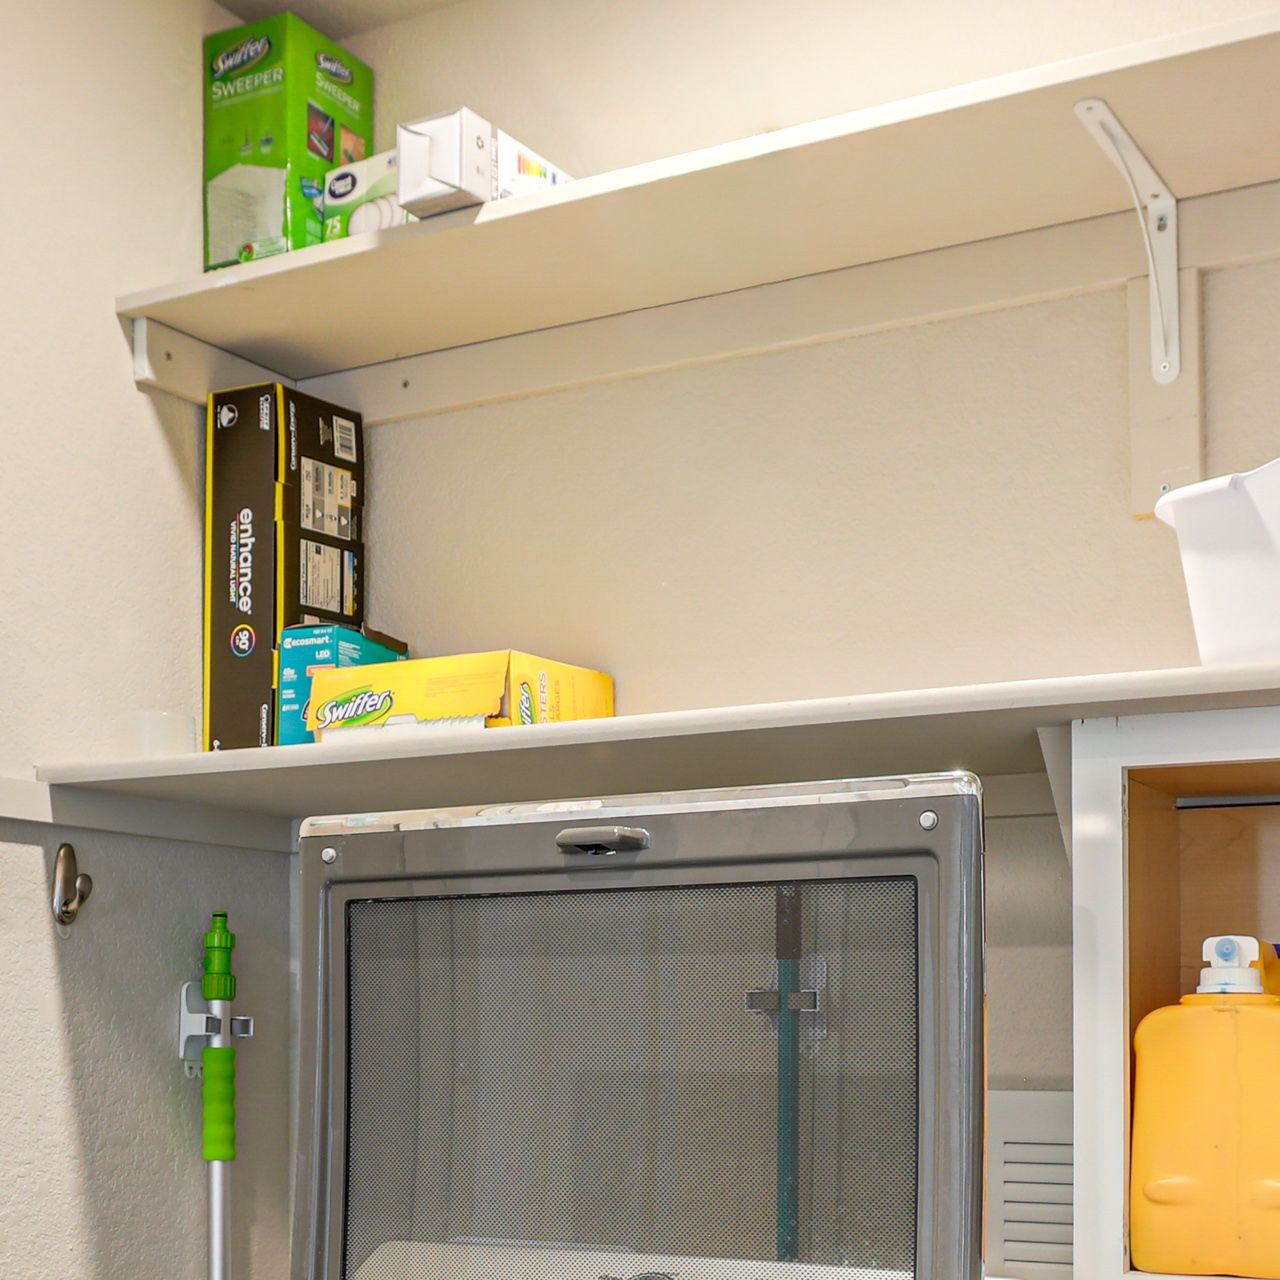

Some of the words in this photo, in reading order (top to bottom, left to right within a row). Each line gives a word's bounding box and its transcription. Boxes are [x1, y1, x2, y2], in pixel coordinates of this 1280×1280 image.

[213, 35, 269, 79] Swiffer
[212, 67, 284, 100] SWEEPER
[238, 507, 255, 612] enhance
[290, 635, 330, 646] ecosmart
[318, 690, 391, 729] Swiffer
[538, 671, 547, 725] STERS
[261, 704, 269, 747] Conserv-
